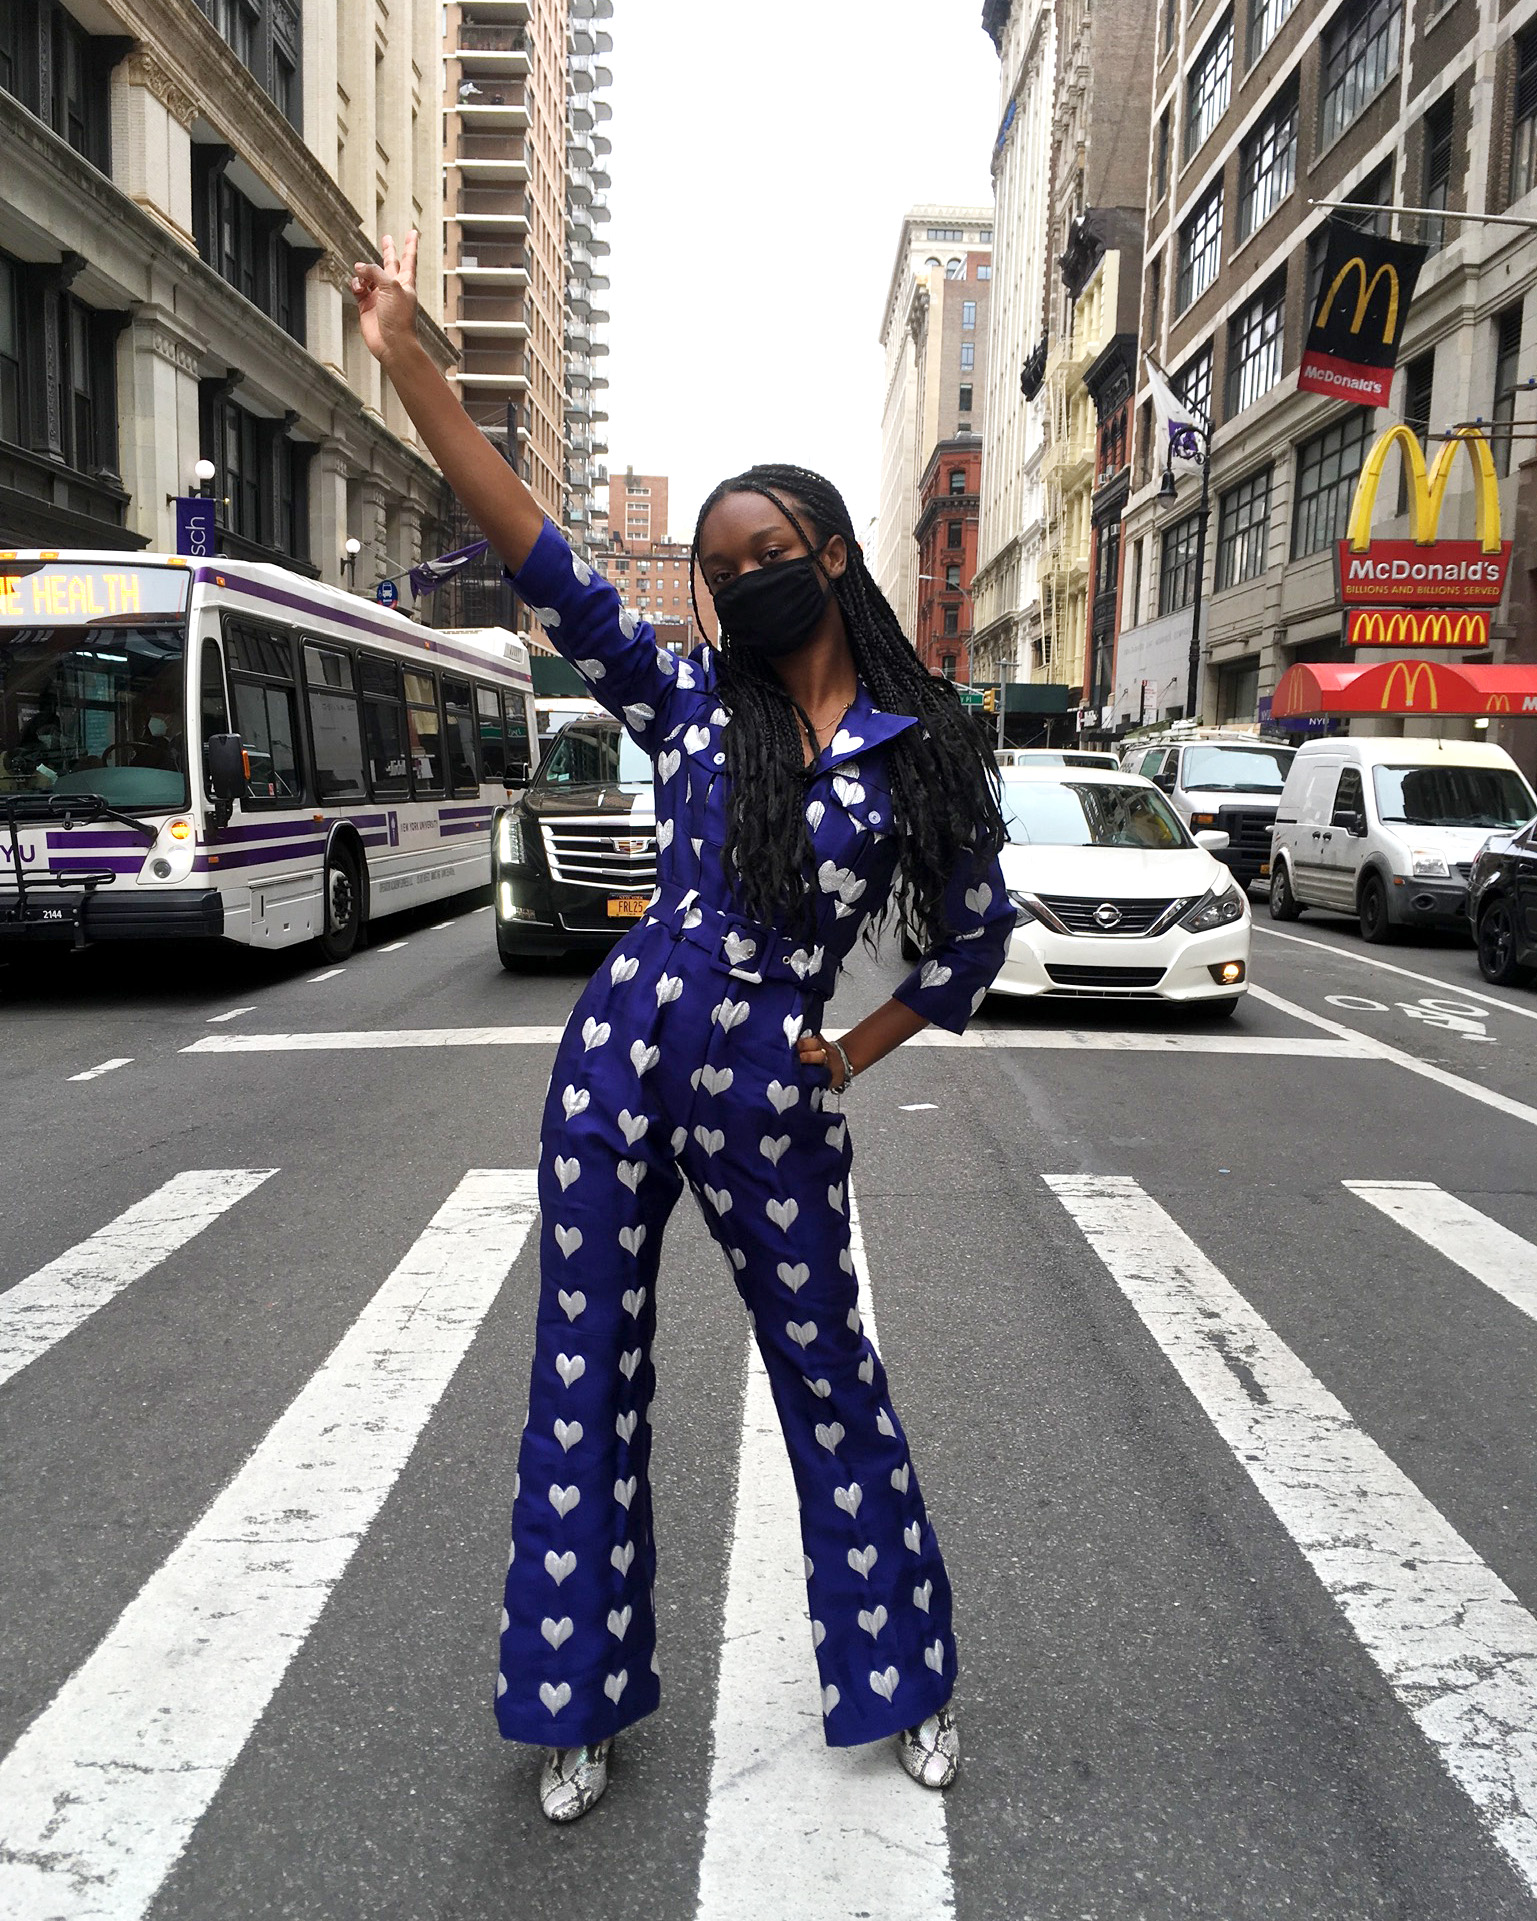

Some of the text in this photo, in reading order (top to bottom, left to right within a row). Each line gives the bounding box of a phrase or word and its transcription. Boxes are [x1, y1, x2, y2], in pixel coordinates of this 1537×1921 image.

[1304, 365, 1383, 394] McDonald's
[1349, 559, 1500, 581] McDonald's
[32, 573, 140, 616] HEALTH
[1345, 585, 1500, 595] BILLIONS AND BILLIONS SERVED
[43, 910, 62, 919] 2144
[618, 901, 643, 913] FRL25
